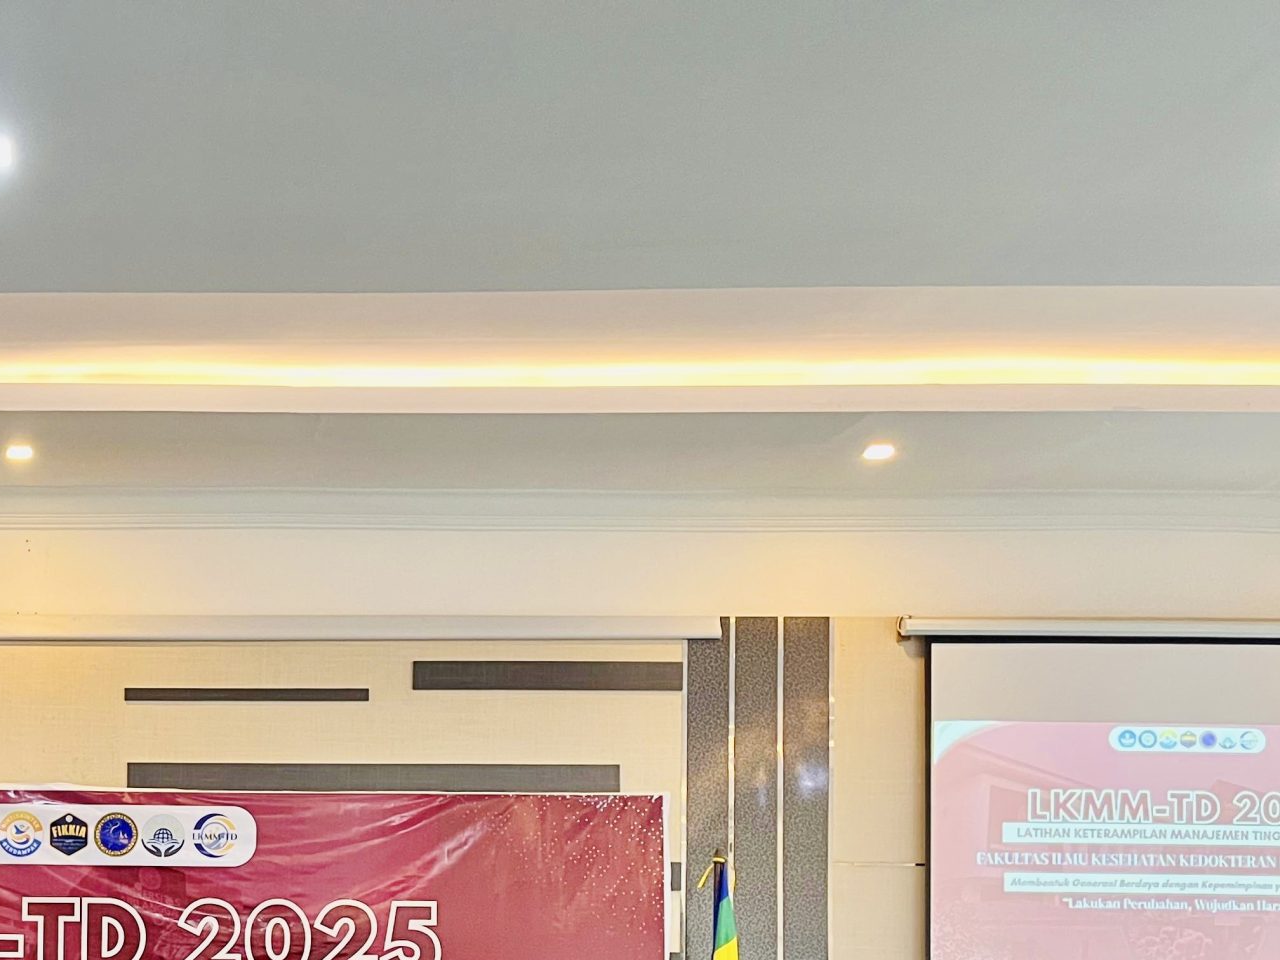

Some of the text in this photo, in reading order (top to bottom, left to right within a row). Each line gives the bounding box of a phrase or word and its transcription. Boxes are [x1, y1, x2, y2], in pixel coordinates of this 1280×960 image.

[1027, 788, 1280, 825] LKMM-TD 20
[51, 824, 87, 838] FIKKIA
[1017, 827, 1280, 841] LATIHAN KETERAMPILAN MANAJEMEN TING
[976, 852, 1276, 868] FAKULTAS ILMU KESEHATAN KEDOKTERAN
[1010, 878, 1070, 887] Membentuk
[1072, 878, 1117, 887] Generasi
[1119, 879, 1159, 890] Berdaya
[1161, 880, 1199, 890] dengan
[1195, 899, 1254, 913] Wujudkan
